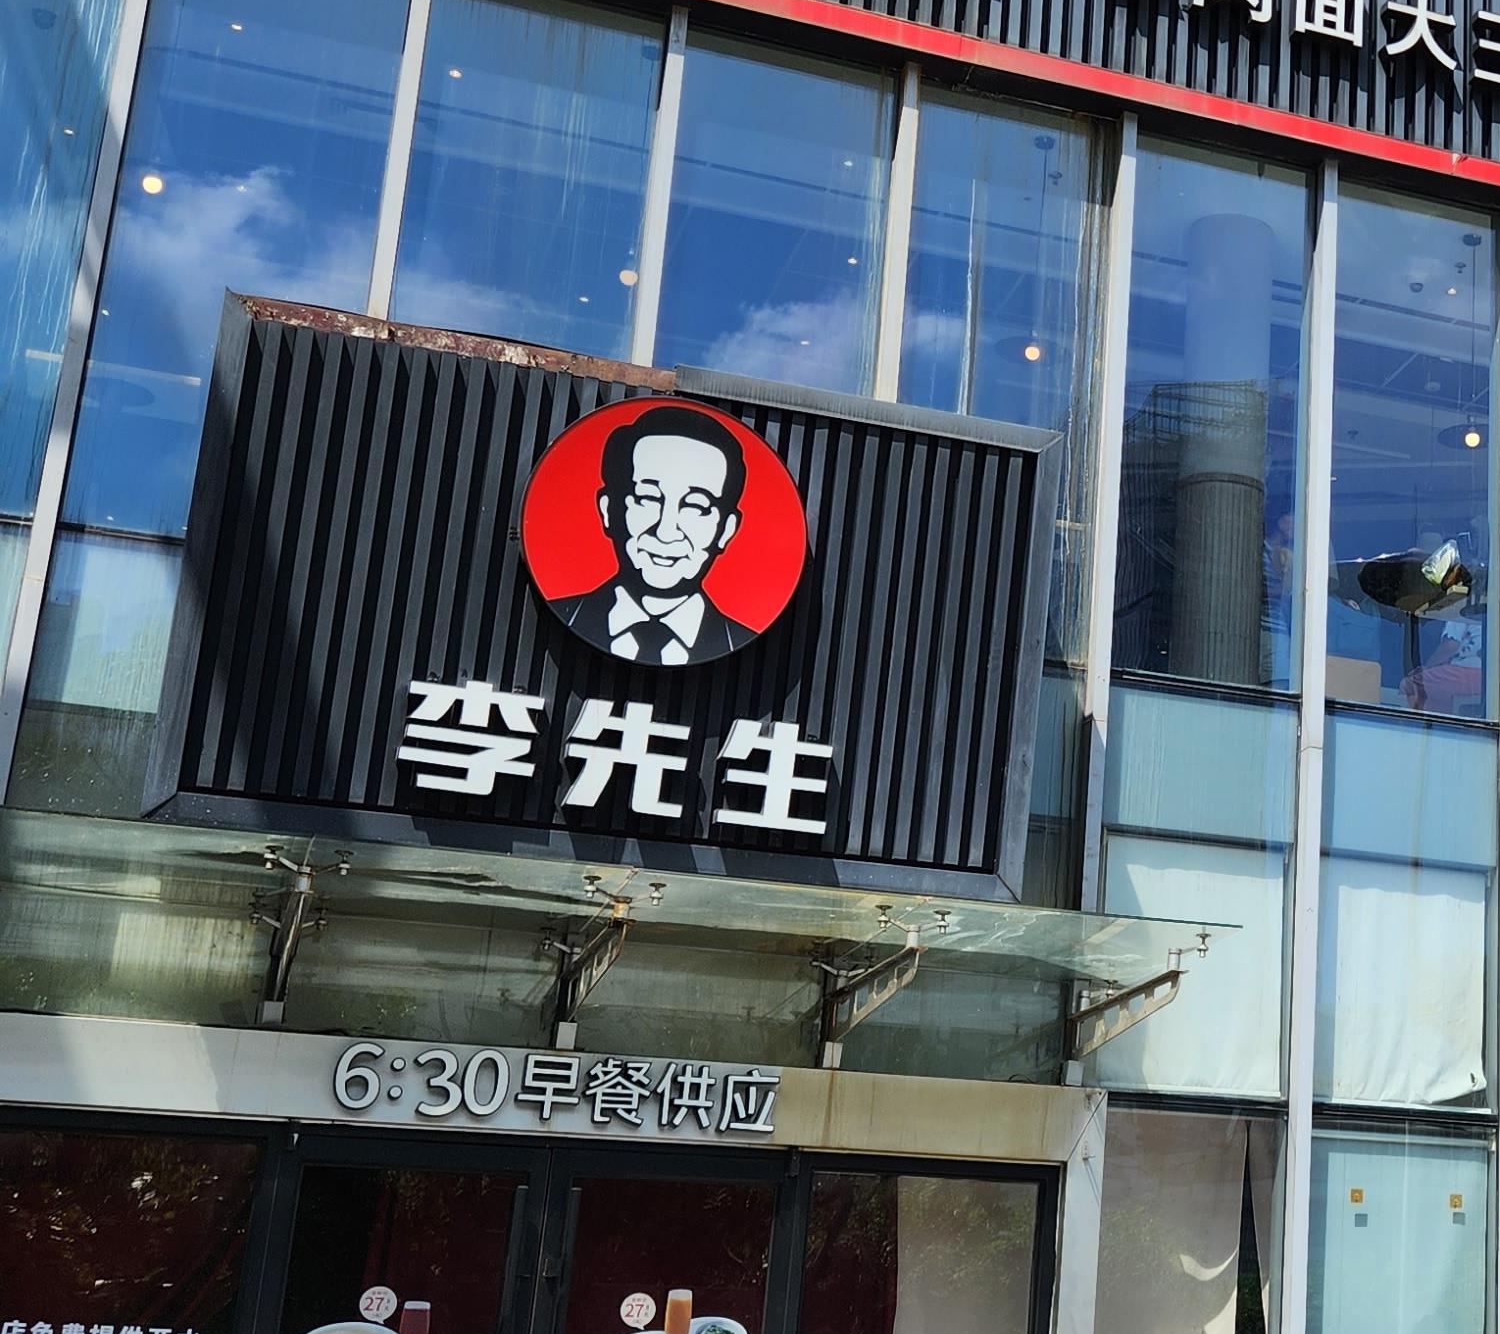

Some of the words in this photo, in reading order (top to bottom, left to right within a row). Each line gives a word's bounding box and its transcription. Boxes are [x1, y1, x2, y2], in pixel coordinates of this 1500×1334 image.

[397, 679, 834, 836] 李先生
[332, 1041, 782, 1135] 6:30早餐供应
[624, 1303, 645, 1318] 27
